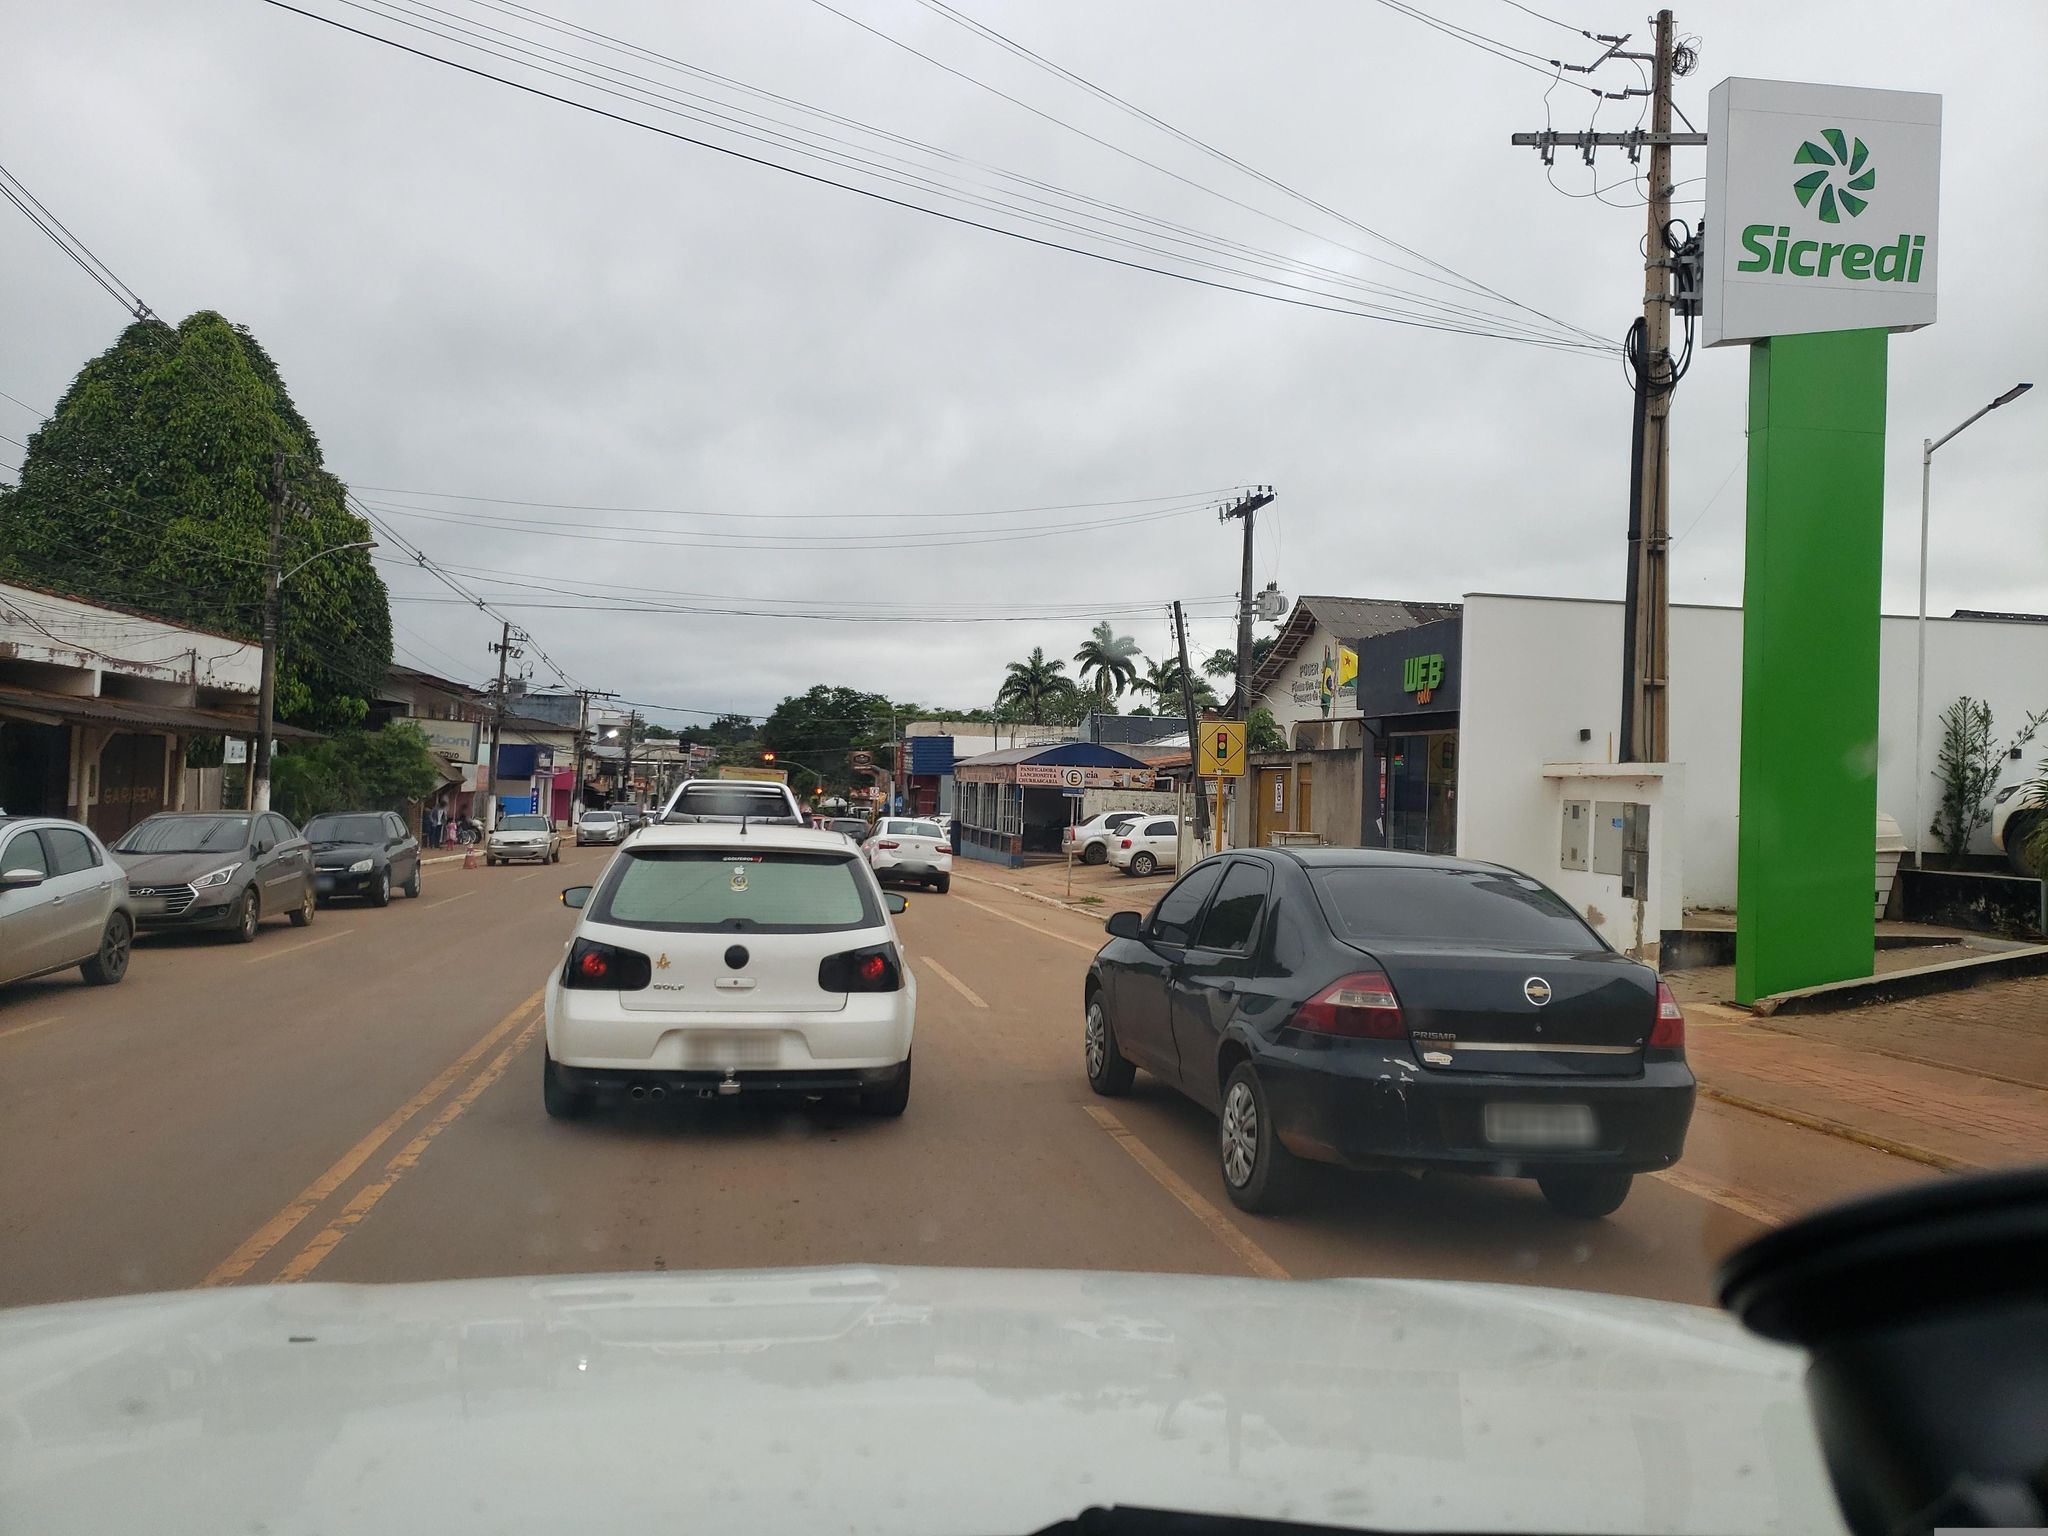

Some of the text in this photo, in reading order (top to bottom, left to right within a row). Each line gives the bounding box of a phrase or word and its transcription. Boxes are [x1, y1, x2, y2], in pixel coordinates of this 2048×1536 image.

[1737, 223, 1926, 283] Sicredi
[1403, 653, 1445, 693] WEB
[1070, 772, 1078, 784] E
[653, 983, 685, 991] GOLF
[1412, 1031, 1457, 1041] PRISMA
